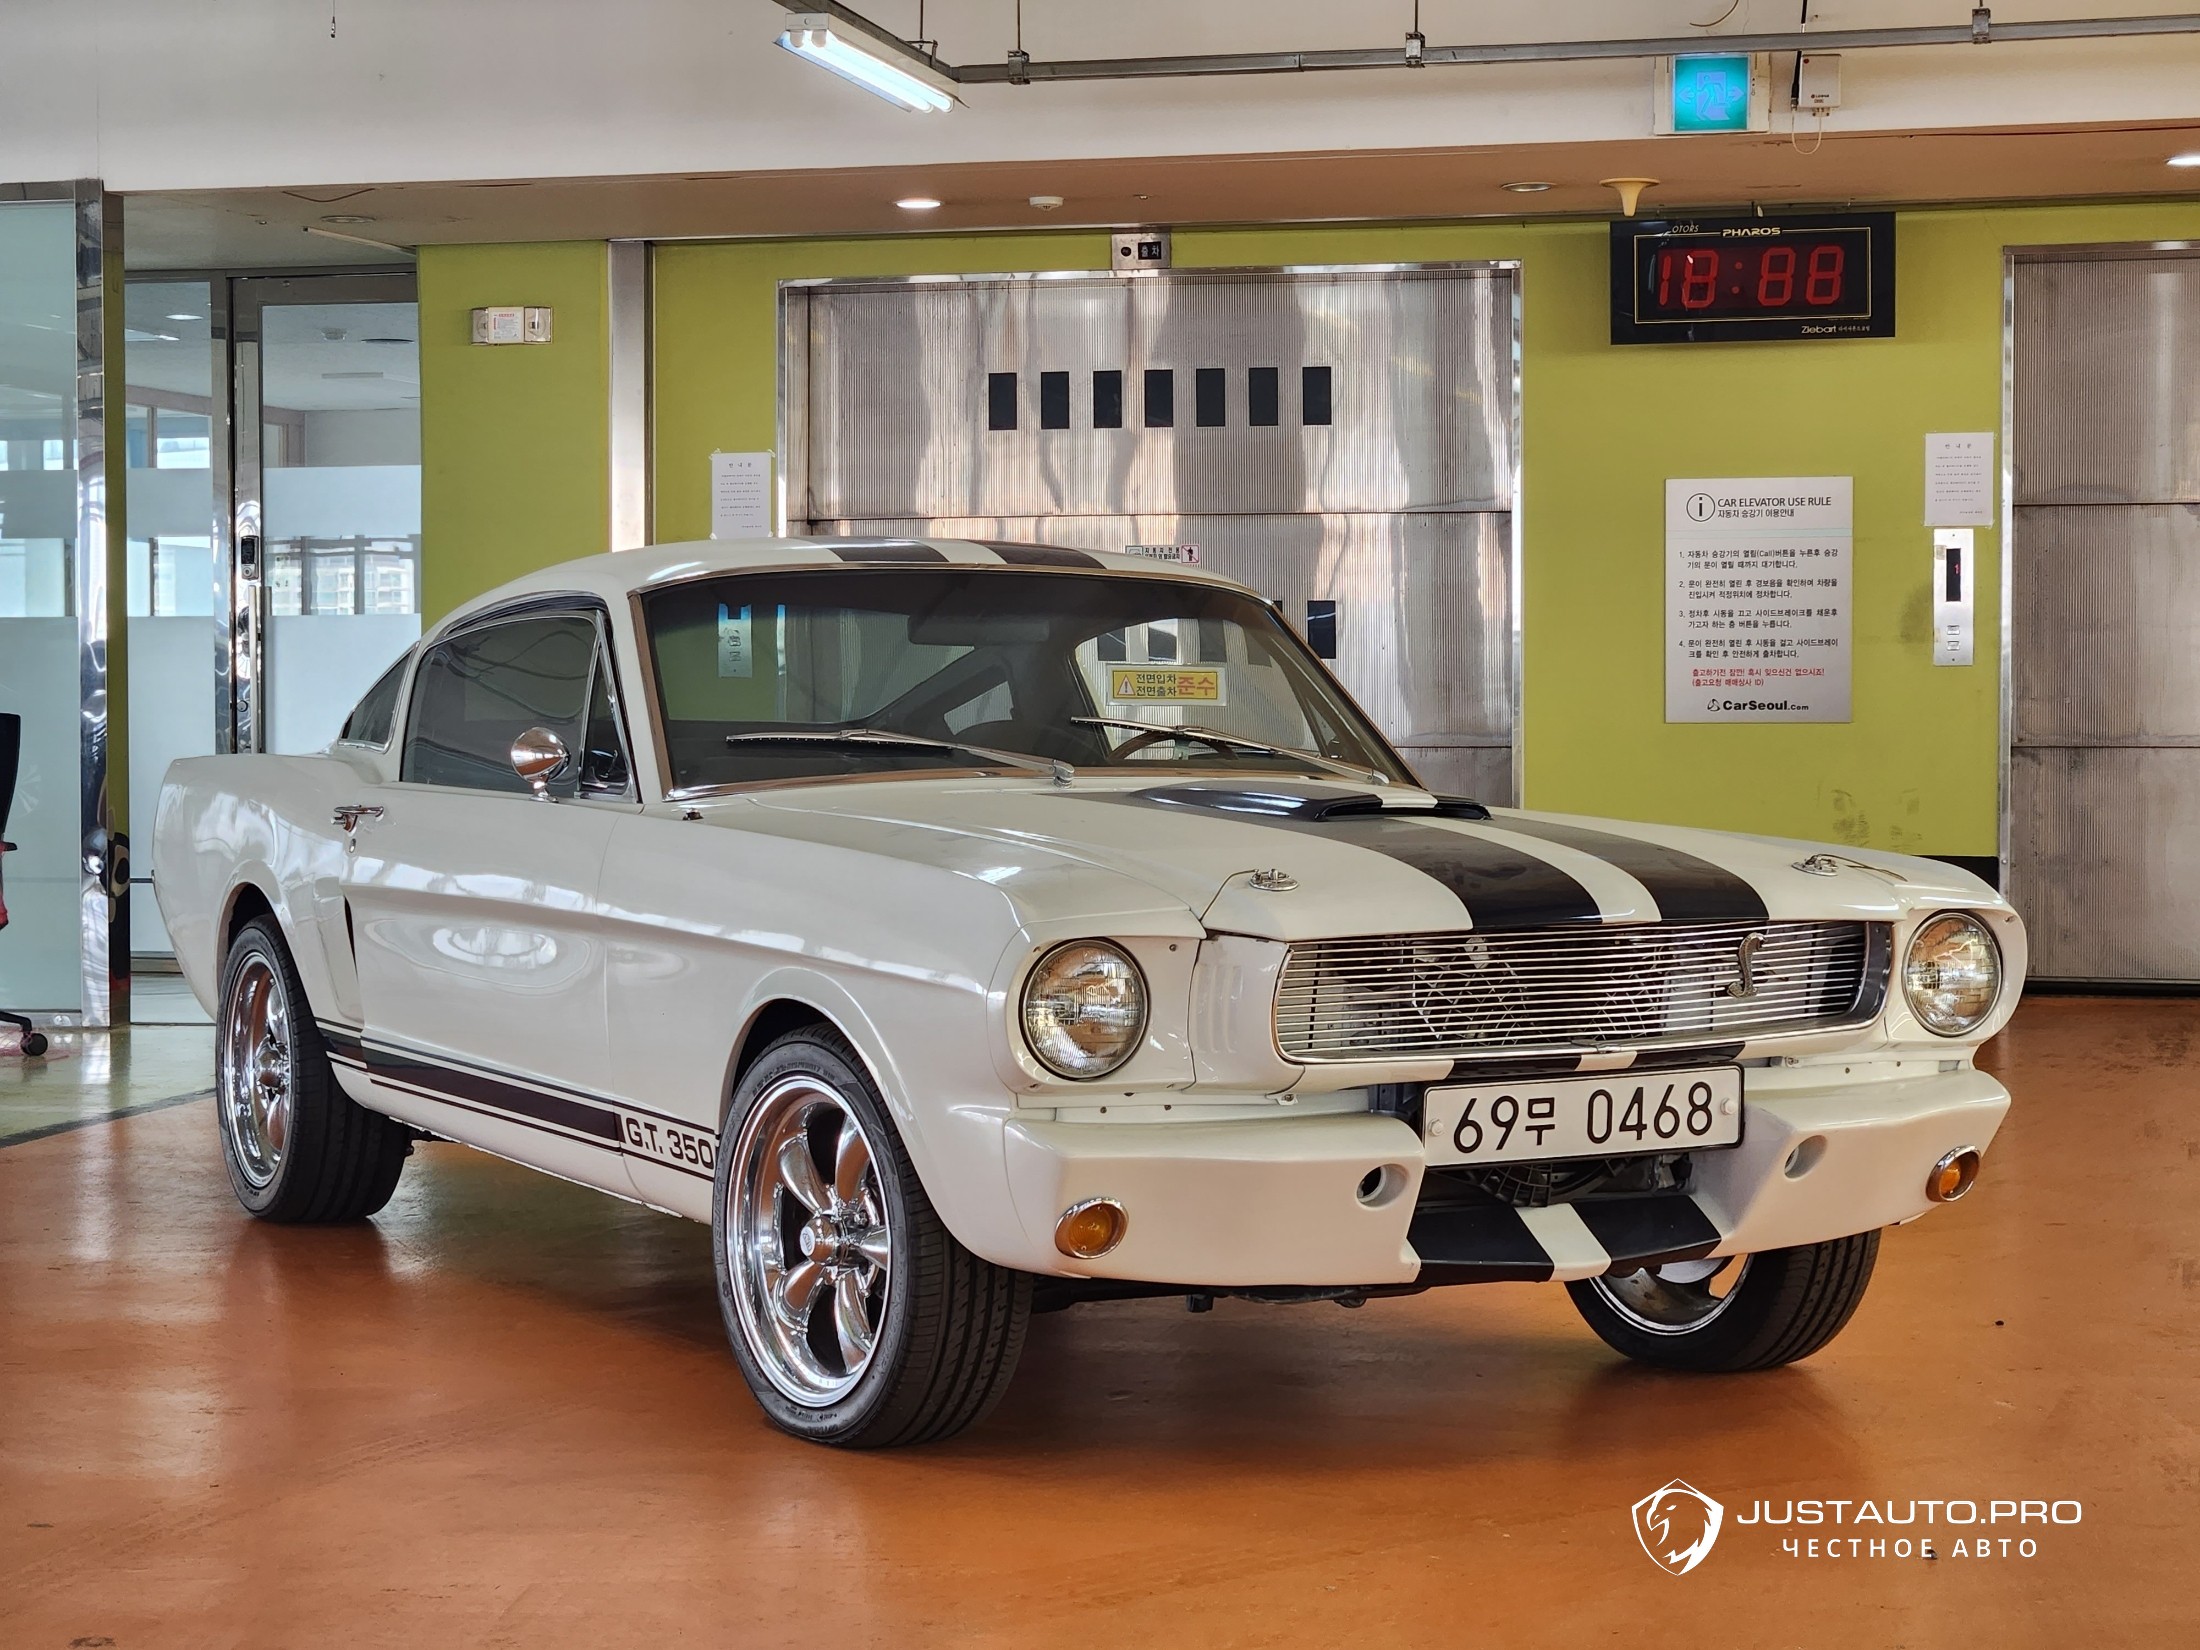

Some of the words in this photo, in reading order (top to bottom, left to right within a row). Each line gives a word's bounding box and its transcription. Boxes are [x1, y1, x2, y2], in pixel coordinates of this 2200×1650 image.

[1722, 227, 1781, 237] PHAROS
[1801, 325, 1837, 334] Ziebart
[1717, 498, 1737, 508] CAR
[1739, 497, 1786, 507] ELEVATOR
[1787, 497, 1806, 507] USE
[1807, 496, 1832, 506] RULE
[1717, 509, 1740, 518] 자동차
[1741, 509, 1763, 518] 승강기
[1765, 508, 1795, 517] 이용안내
[1687, 550, 1708, 558] 자동차
[1712, 550, 1740, 558] 승강기의
[1799, 549, 1820, 557] 누른후
[1824, 549, 1838, 557] 승강
[1687, 561, 1701, 569] 기의
[1704, 561, 1718, 569] 문이
[1761, 560, 1798, 568] 대기합니다.
[1688, 579, 1702, 588] 문이
[1705, 579, 1726, 588] 완전히
[1755, 579, 1783, 588] 경보음을
[1786, 579, 1814, 587] 확인하여
[1817, 578, 1838, 587] 차량을
[1688, 590, 1715, 599] 진입시켜
[1719, 590, 1753, 599] 적정위치에
[1755, 590, 1793, 599] 정차합니다.
[1689, 609, 1709, 618] 정차후
[1713, 609, 1734, 618] 시동을
[1755, 608, 1813, 617] 사이드브레이크를
[1688, 620, 1708, 628] 가고자
[1712, 620, 1725, 628] 하는
[1738, 620, 1759, 628] 버튼을
[1688, 639, 1702, 648] 문이
[1705, 639, 1726, 648] 완전히
[1756, 639, 1776, 647] 시동을
[1796, 638, 1839, 647] 사이드브레이
[1688, 650, 1702, 658] 크를
[1706, 650, 1719, 658] 확인
[1732, 650, 1759, 658] 안전하게
[1763, 649, 1800, 658] 출차합니다.
[1136, 673, 1177, 684] 전면입차
[1177, 676, 1215, 696] 준수
[1136, 686, 1177, 697] 전면출차
[1453, 1095, 1556, 1154] 69무
[1587, 1081, 1713, 1144] 0468
[626, 1117, 664, 1155] G.T.
[667, 1129, 715, 1170] 350
